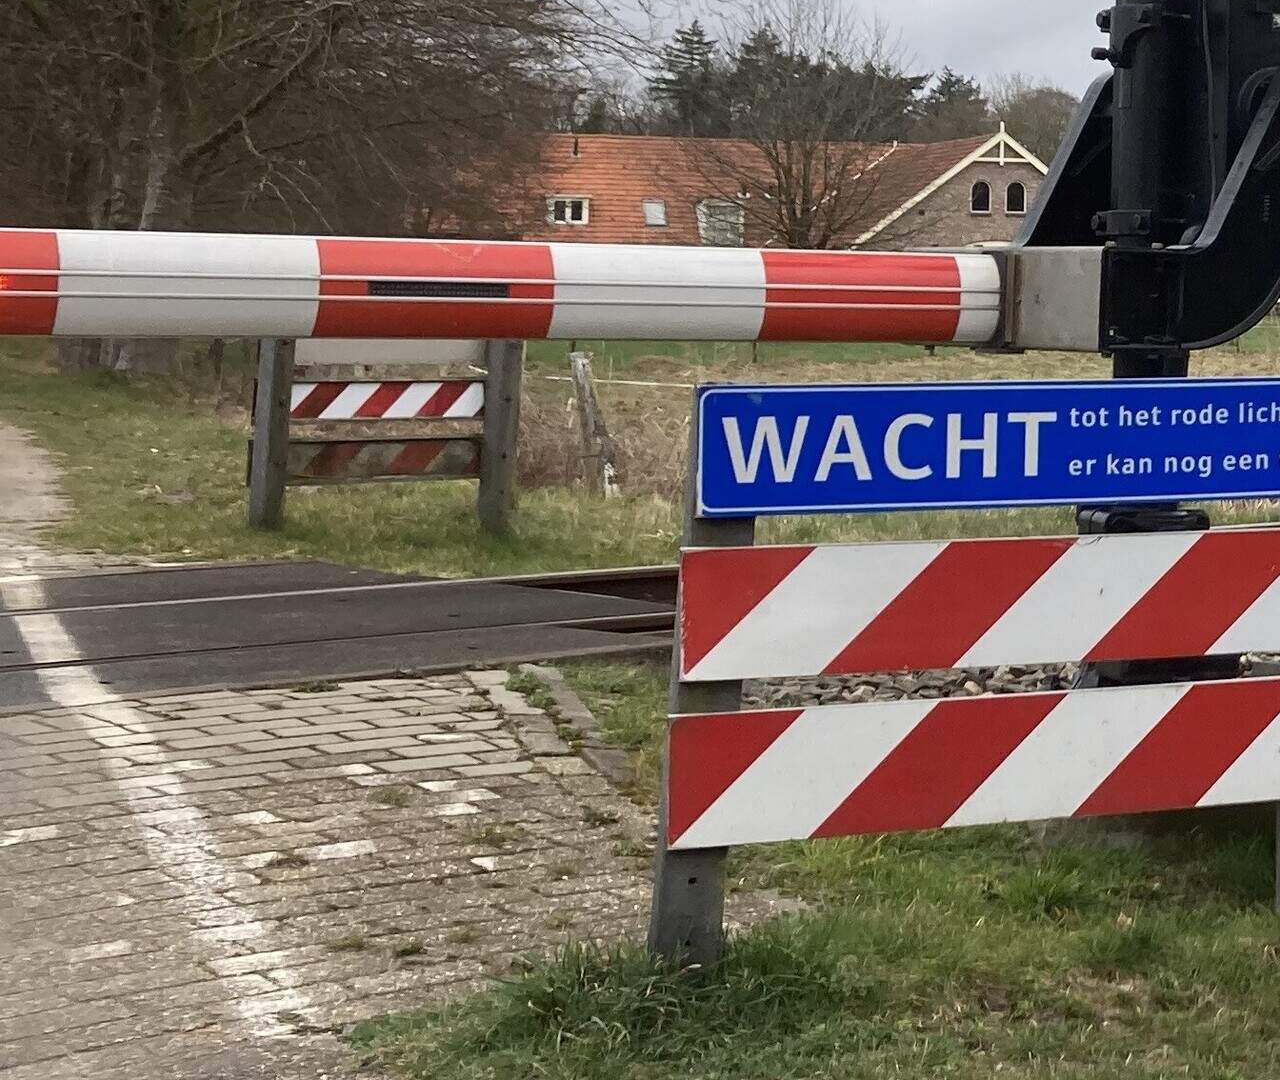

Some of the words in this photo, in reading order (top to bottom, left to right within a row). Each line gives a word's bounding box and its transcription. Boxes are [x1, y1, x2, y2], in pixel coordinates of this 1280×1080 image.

[1069, 407, 1109, 427] tot
[1119, 405, 1161, 427] het
[1171, 403, 1229, 425] rode
[721, 411, 1057, 484] WACHT
[1068, 458, 1097, 476] er
[1106, 453, 1153, 475] kan
[1164, 455, 1213, 478] nog
[1222, 453, 1269, 470] een
